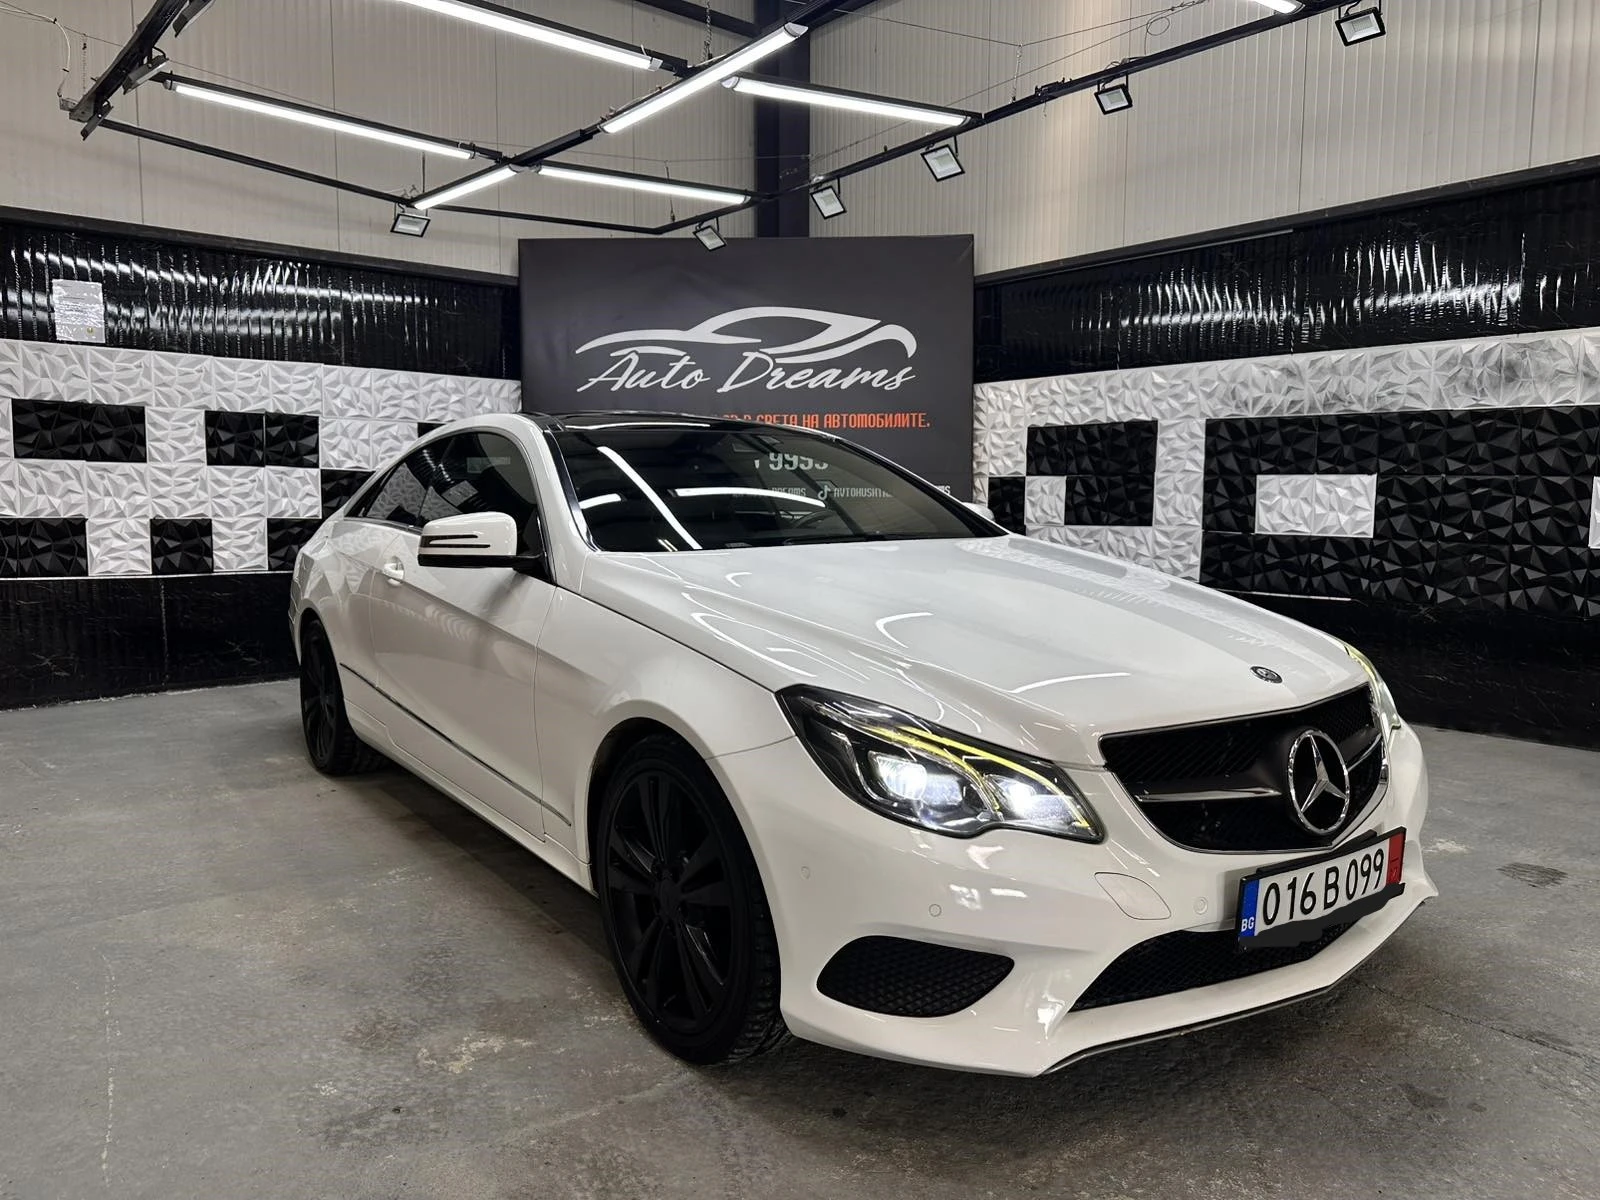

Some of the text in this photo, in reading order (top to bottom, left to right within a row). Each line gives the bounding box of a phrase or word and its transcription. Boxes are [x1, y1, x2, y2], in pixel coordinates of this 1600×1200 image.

[576, 351, 916, 393] Auto Dreams
[802, 413, 819, 429] НА
[823, 412, 931, 429] АВТОМОБИЛИТЕ.
[1240, 916, 1255, 932] BG
